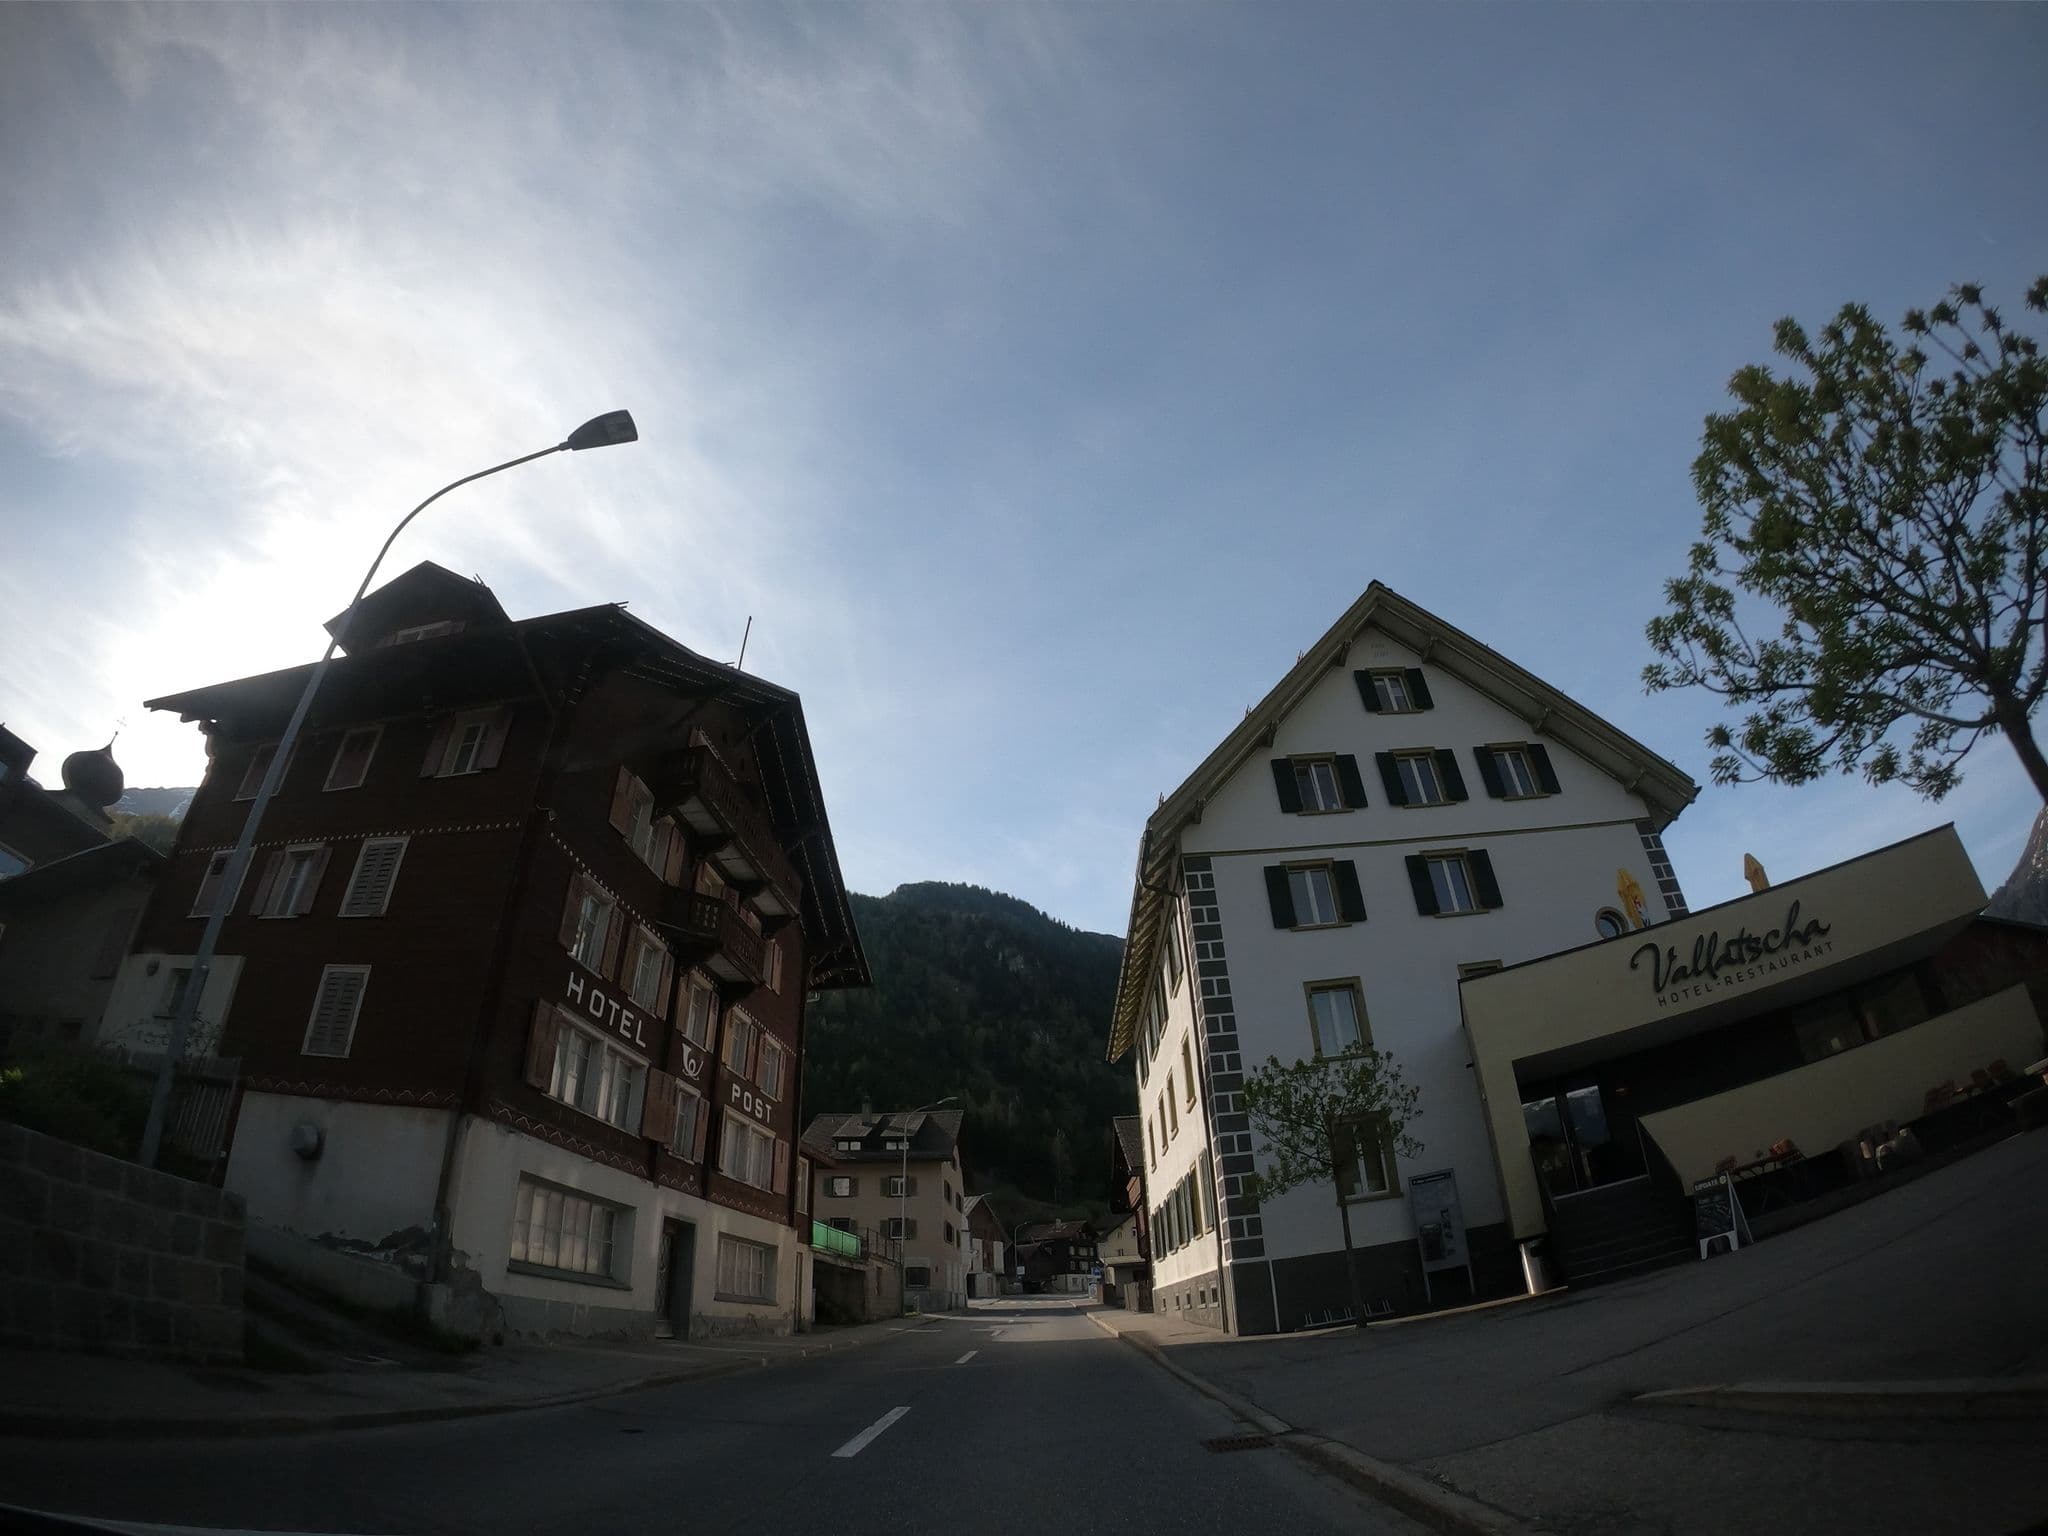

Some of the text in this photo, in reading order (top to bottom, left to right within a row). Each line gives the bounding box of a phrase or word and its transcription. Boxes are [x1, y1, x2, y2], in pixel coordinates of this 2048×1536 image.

[1630, 899, 1831, 993] Vallatscha
[566, 971, 772, 1124] HOTEL POST
